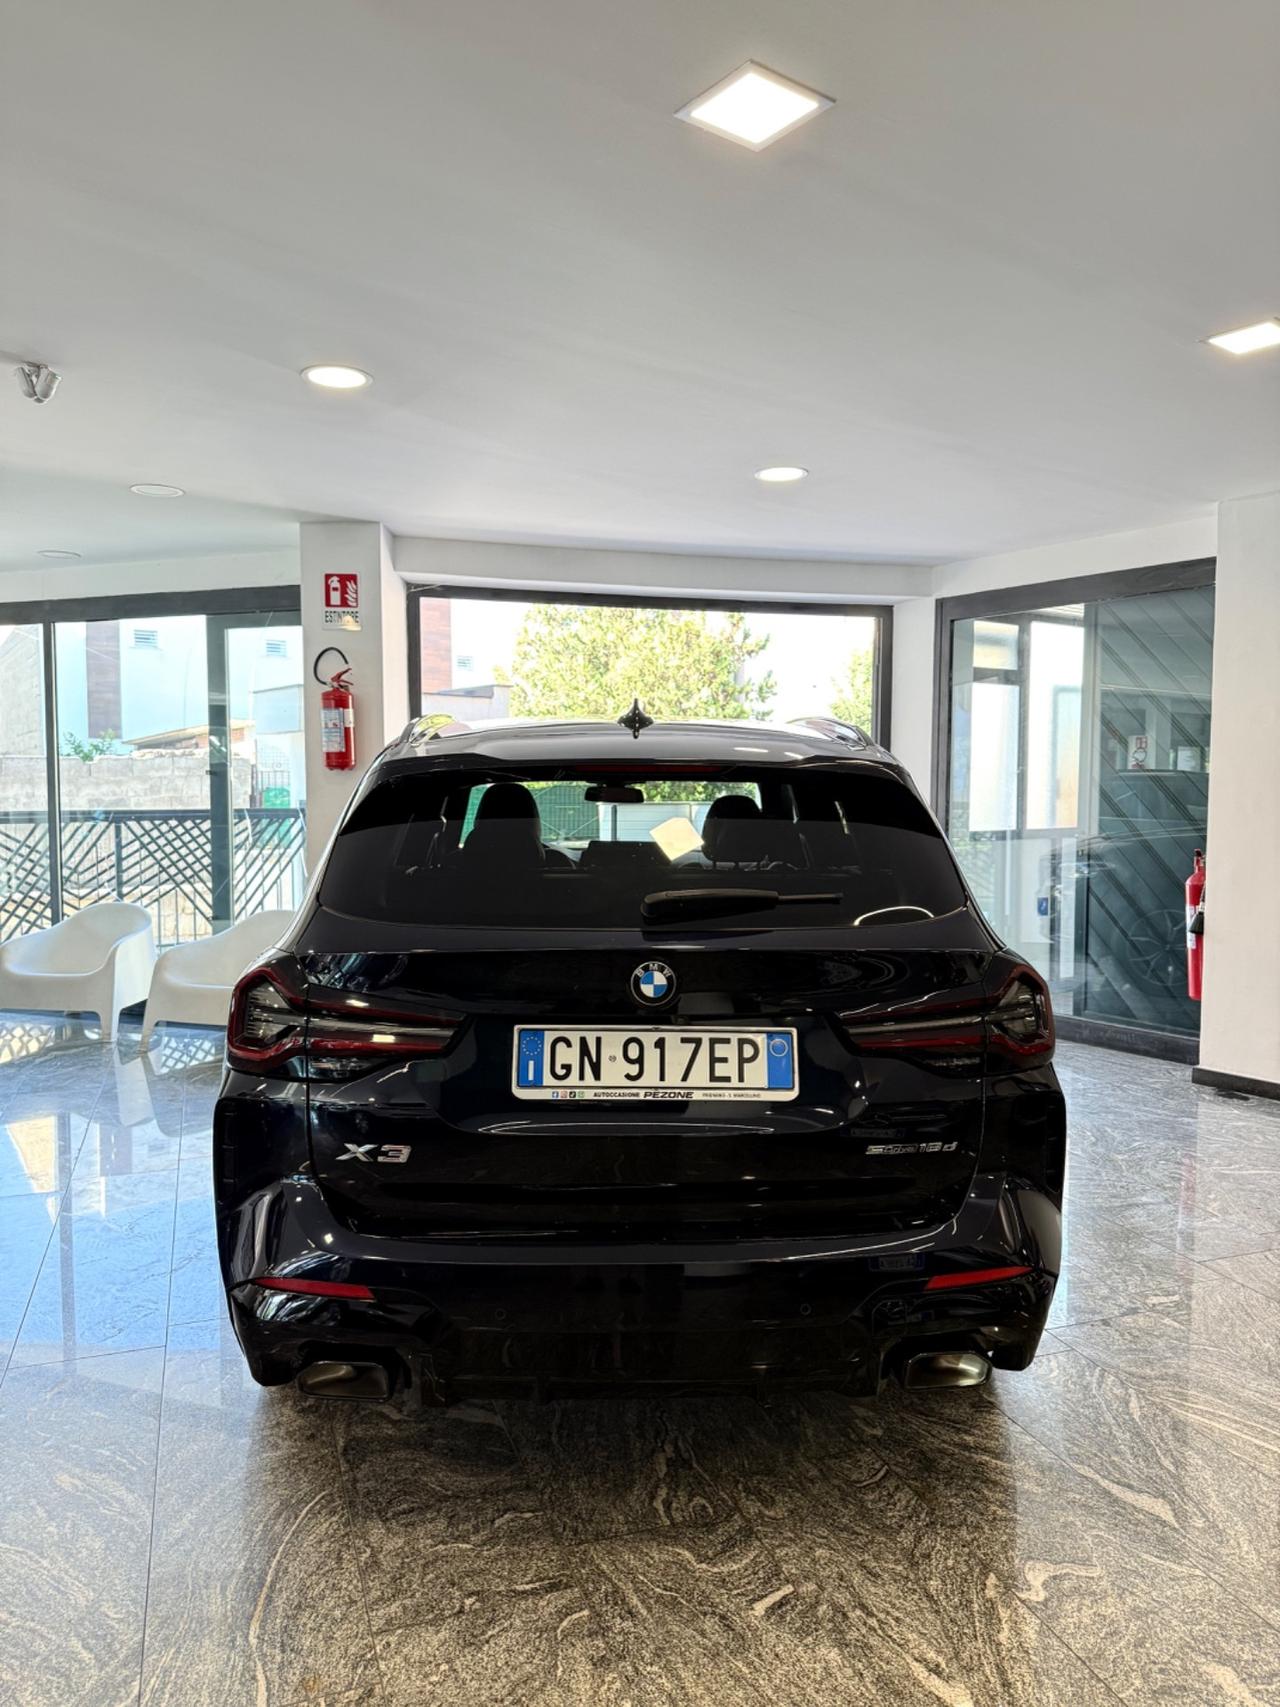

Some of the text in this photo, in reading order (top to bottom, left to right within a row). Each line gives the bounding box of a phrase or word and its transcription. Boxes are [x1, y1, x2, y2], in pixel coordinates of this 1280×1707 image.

[635, 963, 672, 977] BMW
[549, 1036, 602, 1081] GN
[622, 1036, 760, 1083] 917EP
[643, 1091, 695, 1099] PEZONE
[335, 1143, 412, 1163] X3
